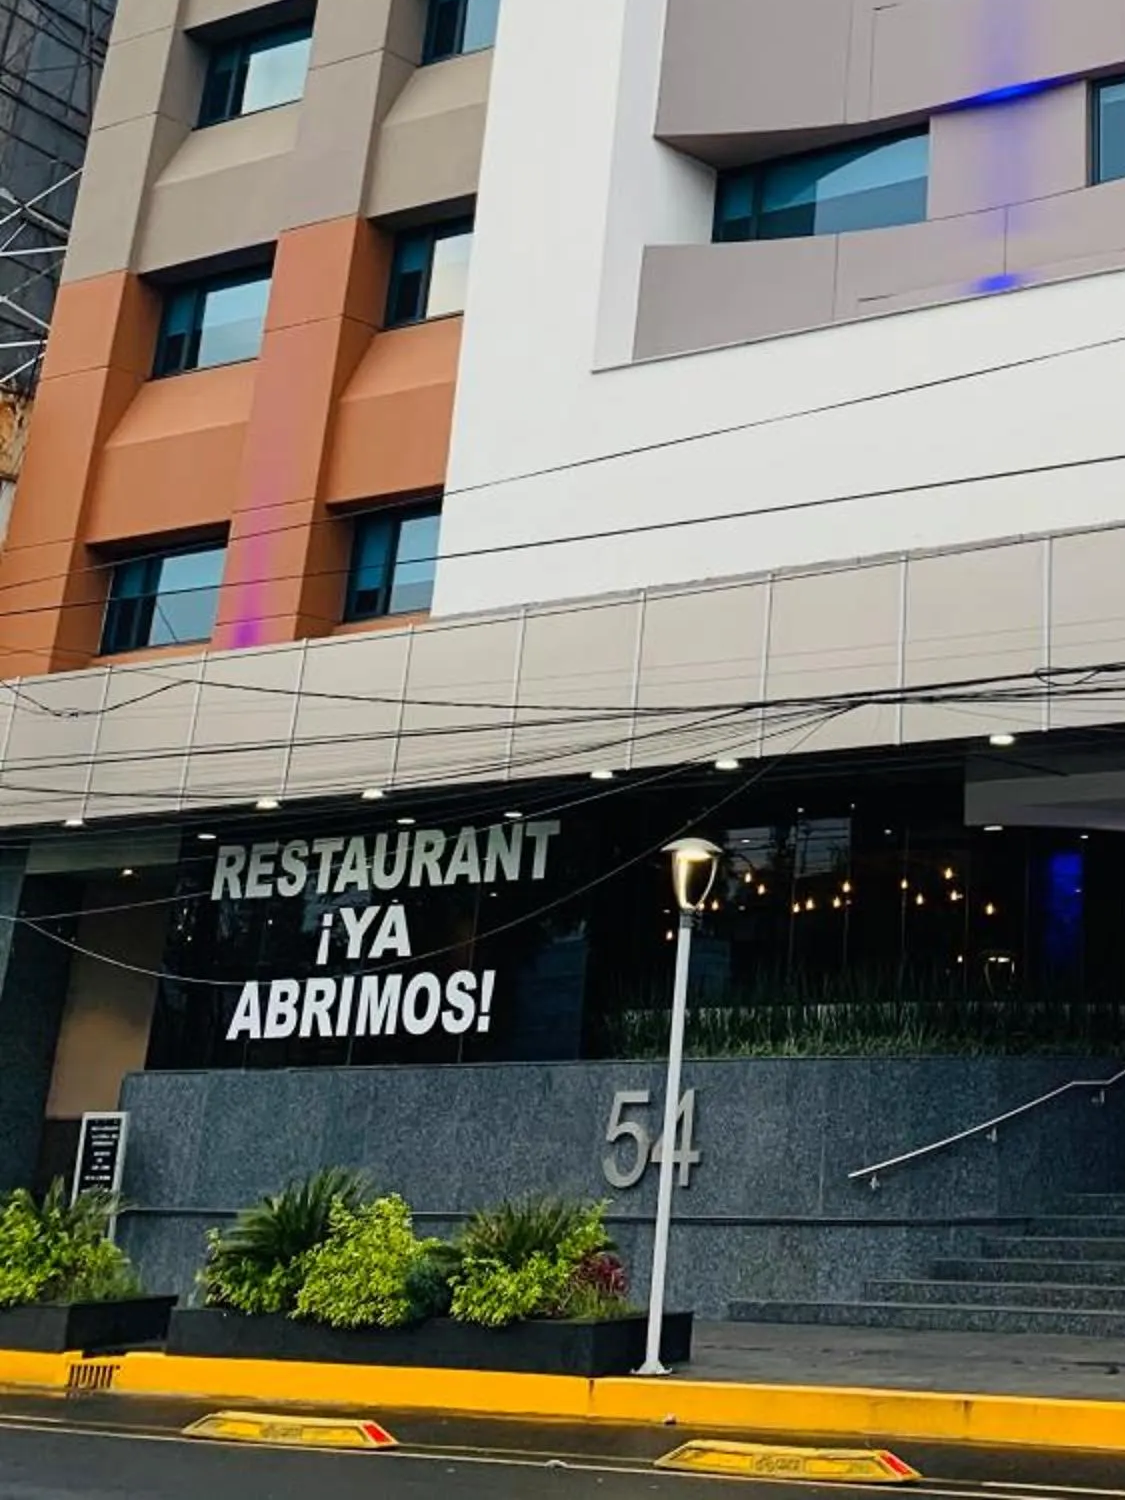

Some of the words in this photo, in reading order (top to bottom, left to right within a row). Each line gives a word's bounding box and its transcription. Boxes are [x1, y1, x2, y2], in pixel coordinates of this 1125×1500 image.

[211, 820, 561, 900] RESTAURANT
[316, 904, 412, 965] ¡YA
[225, 970, 496, 1040] ABRIMOS!
[603, 1088, 700, 1190] 54
